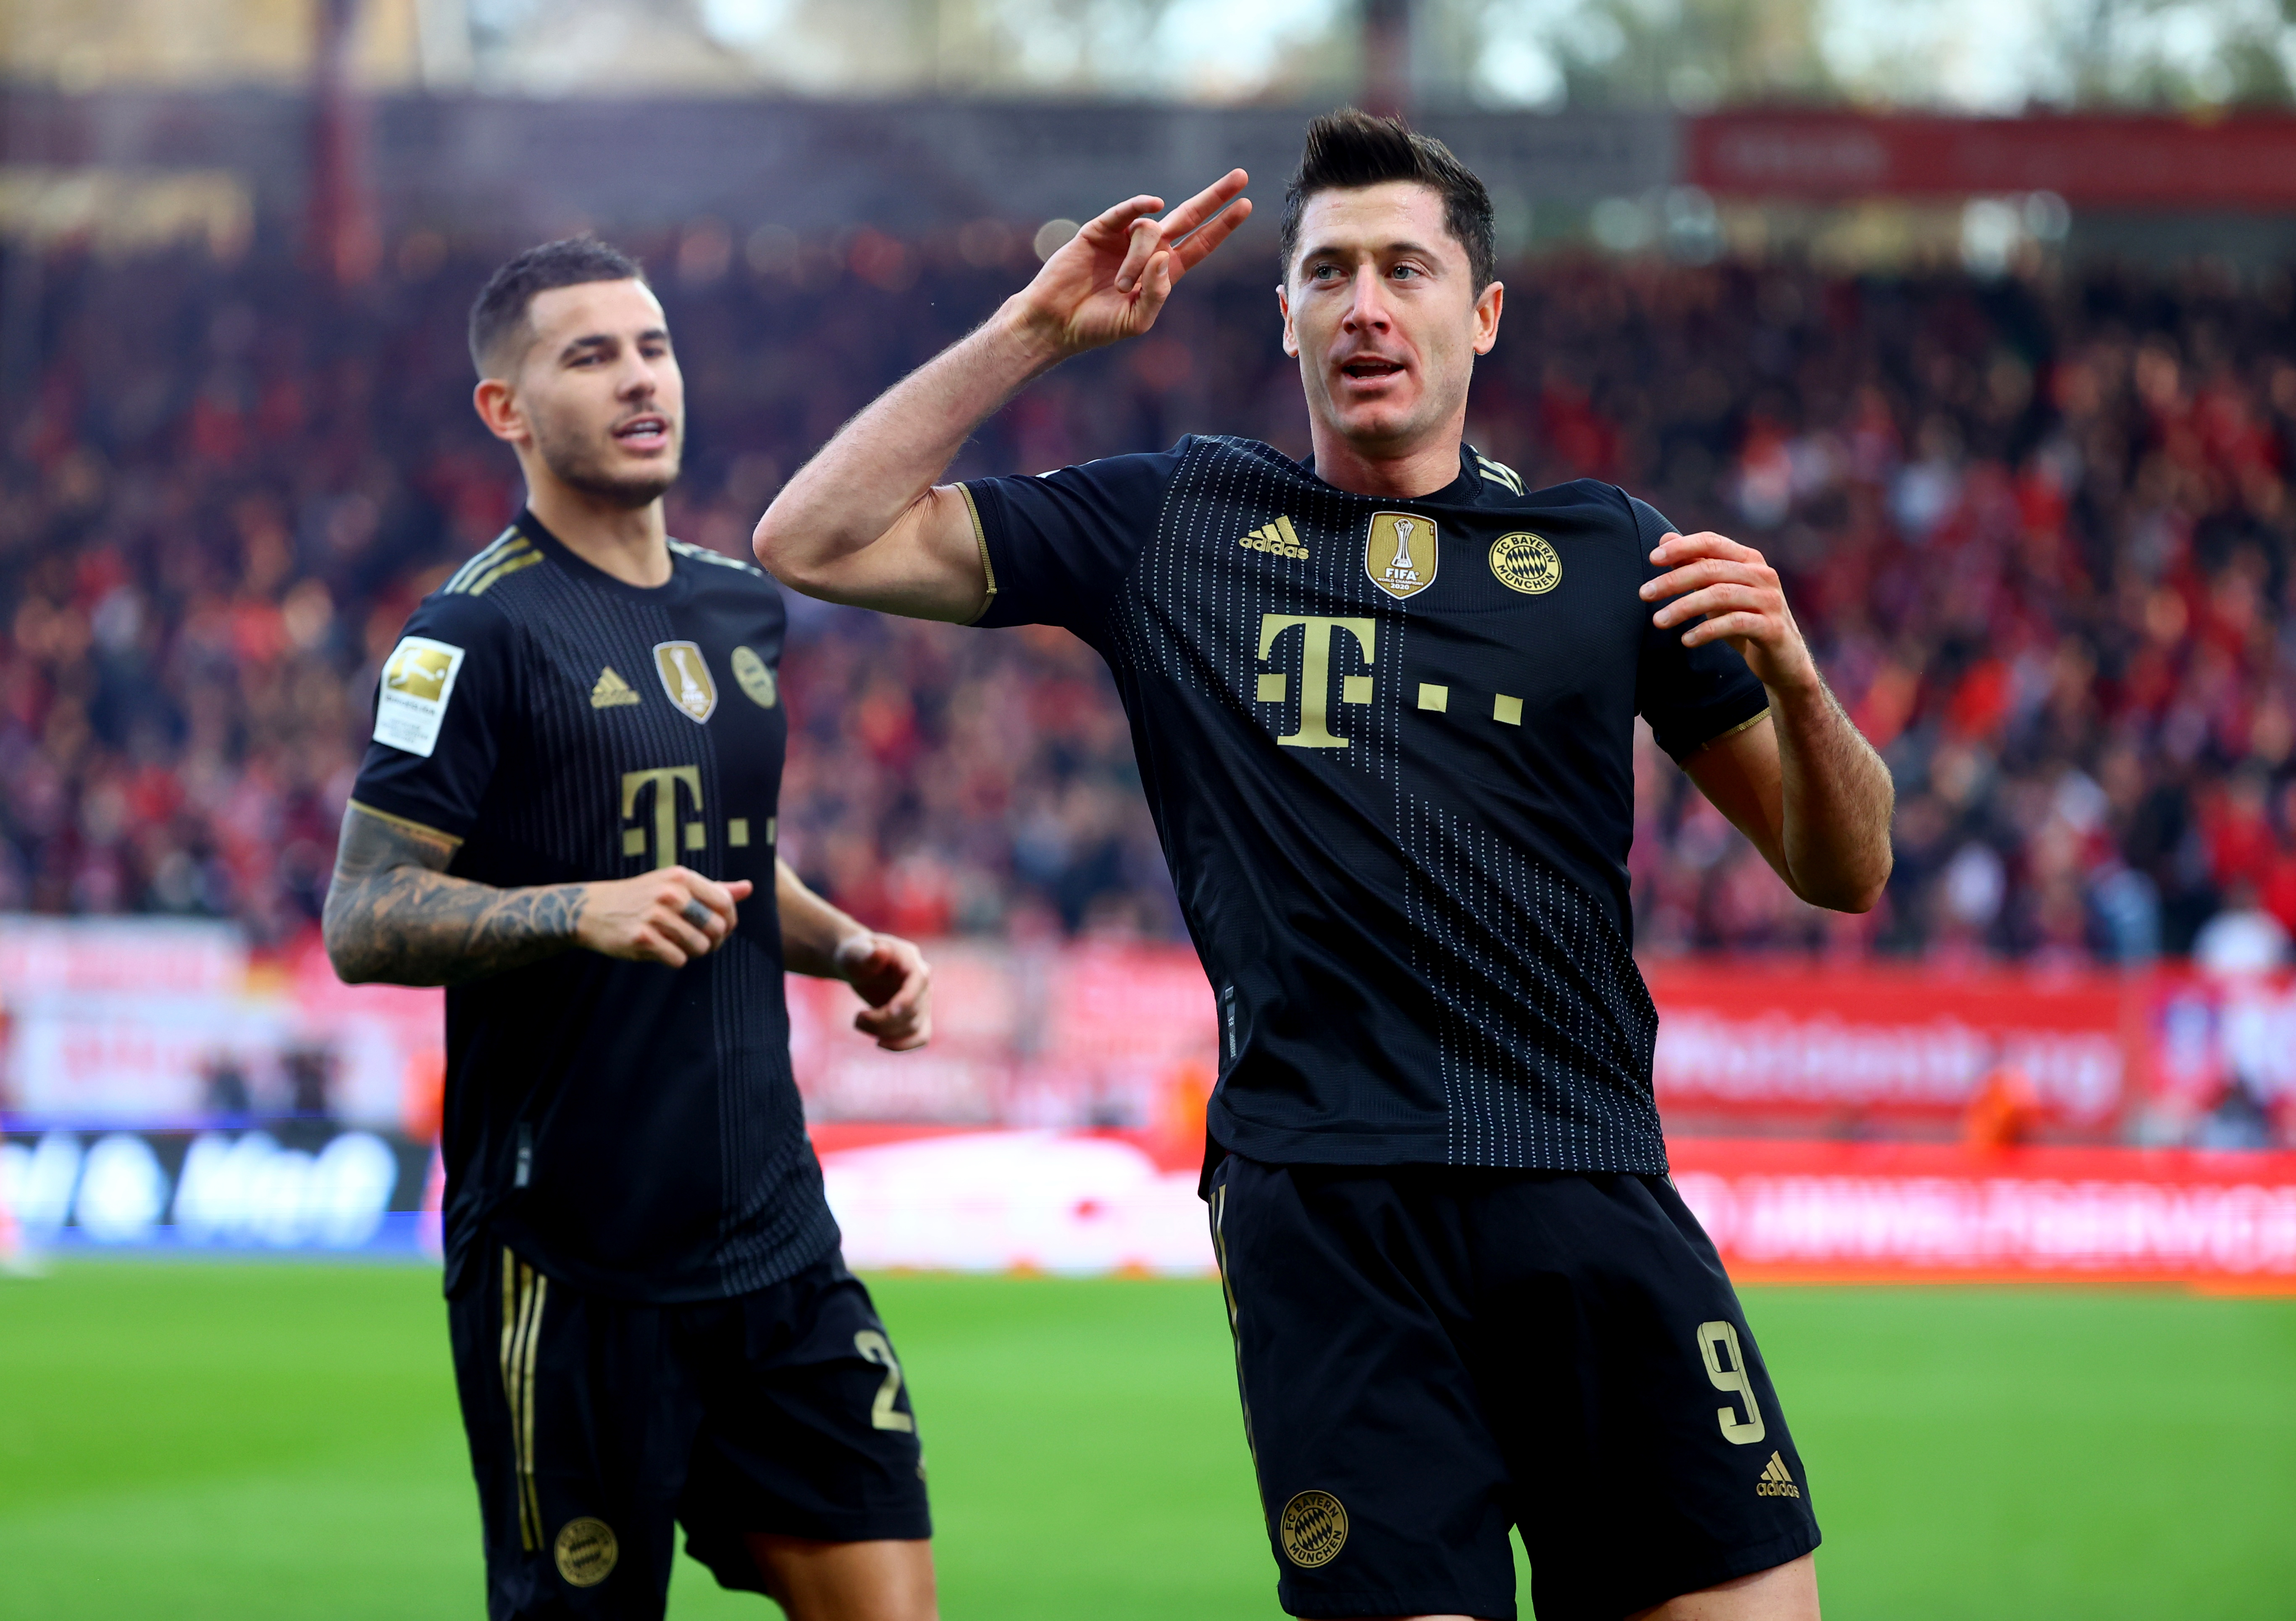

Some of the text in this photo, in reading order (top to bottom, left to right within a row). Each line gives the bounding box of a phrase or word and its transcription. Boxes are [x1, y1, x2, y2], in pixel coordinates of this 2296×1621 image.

[1239, 537, 1309, 560] adidas
[1496, 536, 1555, 563] FC BAYERN
[1497, 564, 1555, 588] MÜNCHEN
[1697, 1321, 1765, 1445] 9
[1756, 1479, 1800, 1498] adidas
[1286, 1495, 1339, 1530] FC BAYERN
[1289, 1530, 1342, 1563] MÜNCHEN
